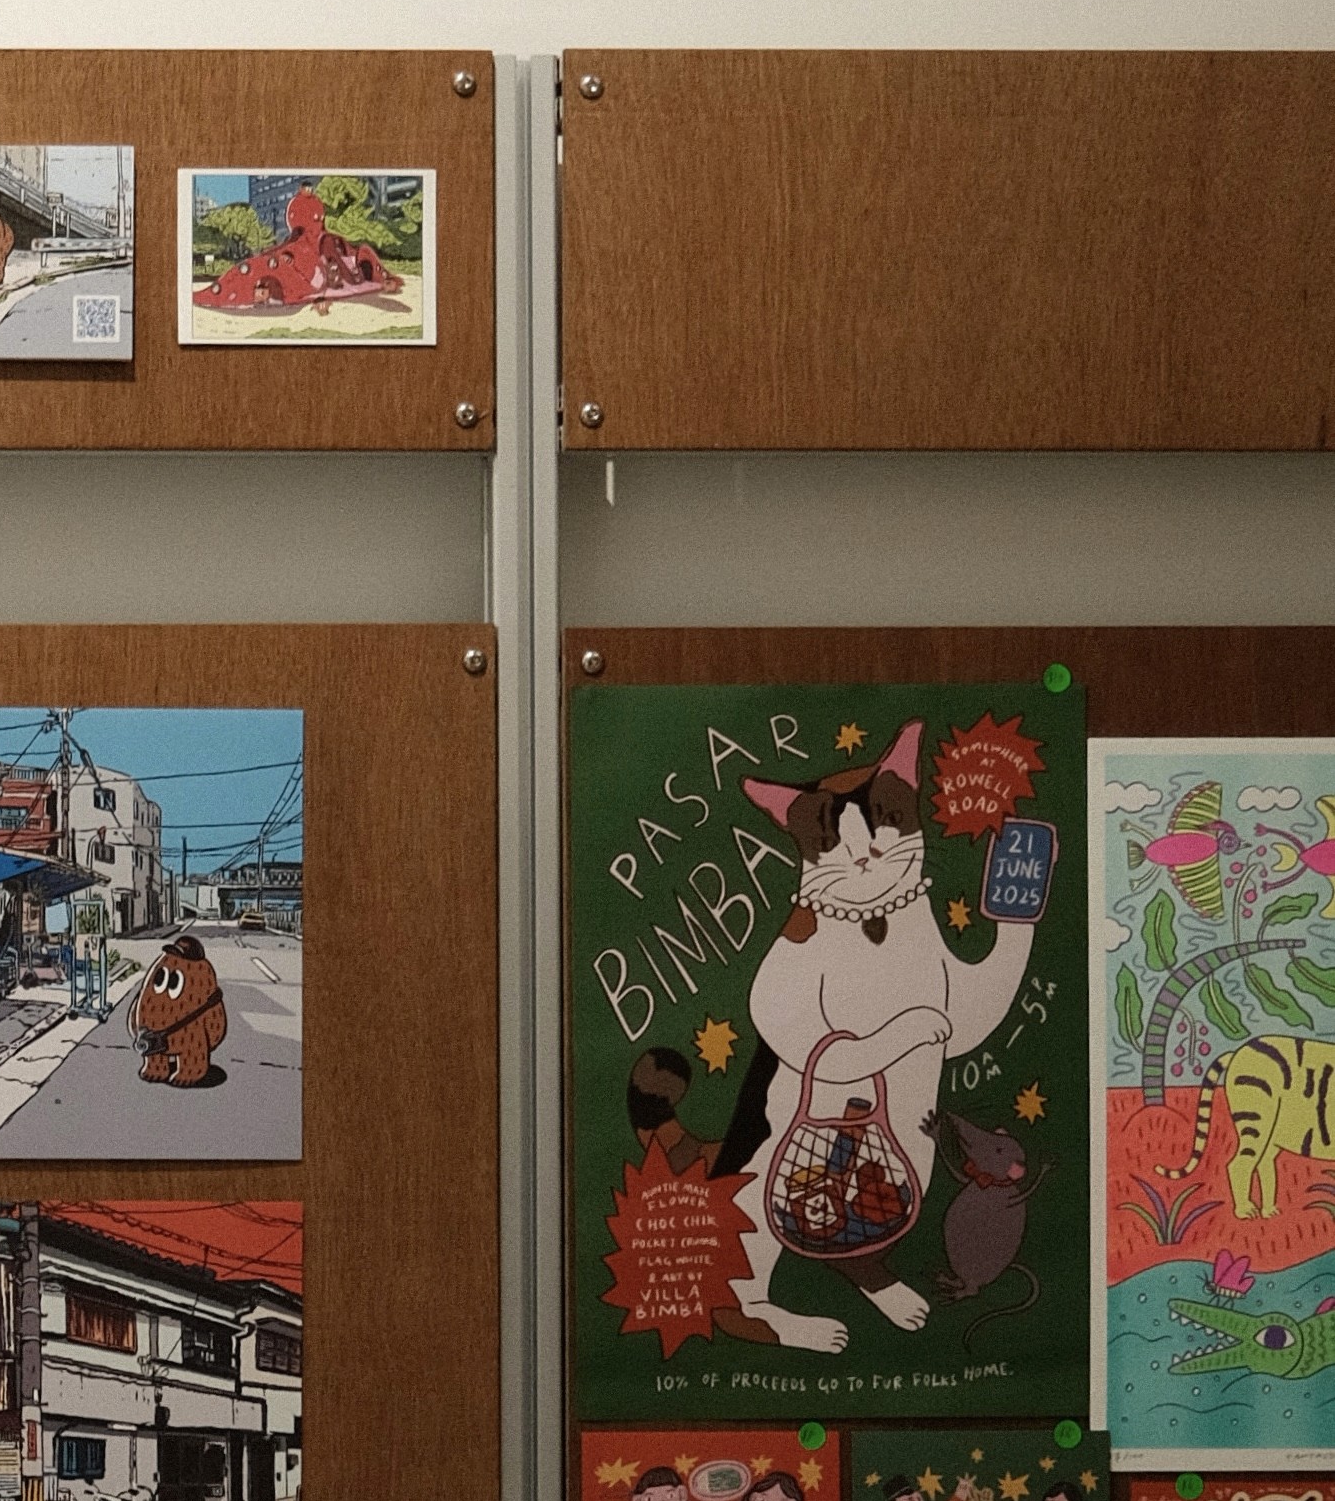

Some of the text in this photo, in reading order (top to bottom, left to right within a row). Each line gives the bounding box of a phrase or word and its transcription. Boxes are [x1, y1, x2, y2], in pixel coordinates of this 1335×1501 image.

[951, 742, 1029, 774] SOMEWHERE
[979, 758, 996, 768] AT
[942, 773, 1011, 800] ROWELL
[609, 713, 810, 900] PASAR
[948, 796, 998, 816] ROAD
[1008, 830, 1034, 854] 21
[995, 858, 1042, 880] JUNE
[991, 886, 1041, 906] 2025
[593, 827, 796, 1041] BIMBA
[641, 1284, 700, 1302] VILLA
[635, 1302, 704, 1319] BIMBA
[656, 1376, 688, 1392] 10%
[702, 1373, 720, 1387] OF
[731, 1373, 806, 1391] PROCEEDS
[846, 1375, 863, 1389] TO
[872, 1374, 902, 1389] FUR
[912, 1372, 957, 1387] FOLKS
